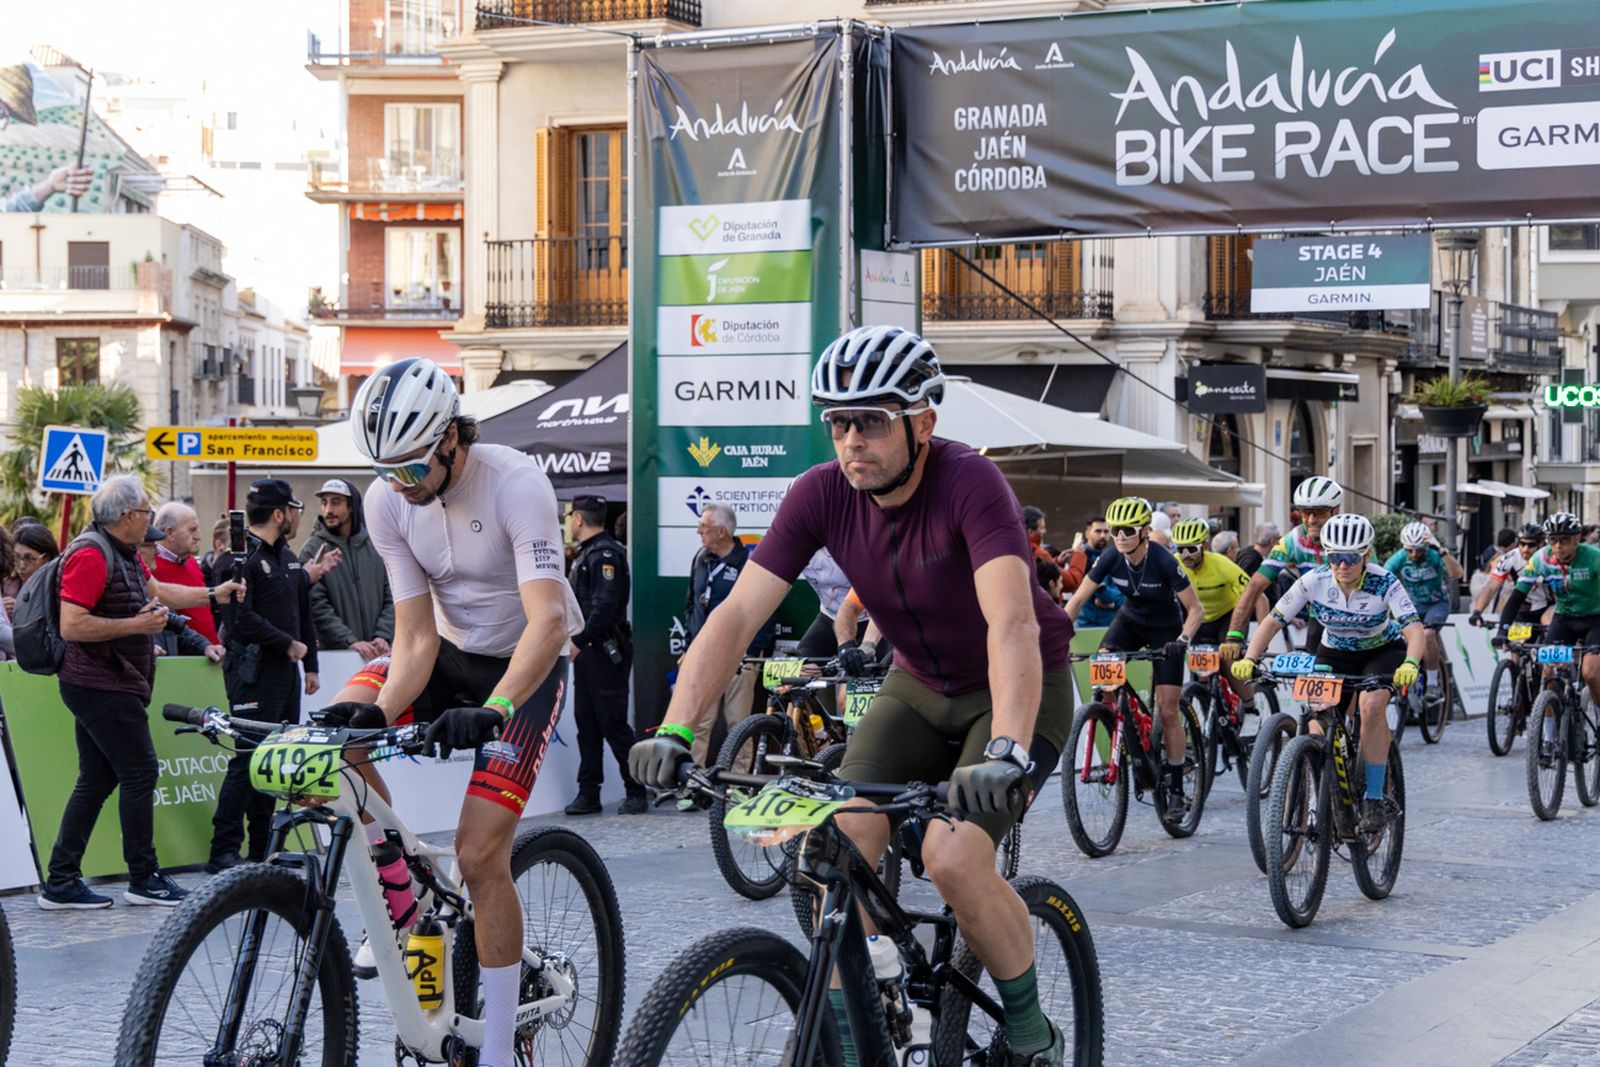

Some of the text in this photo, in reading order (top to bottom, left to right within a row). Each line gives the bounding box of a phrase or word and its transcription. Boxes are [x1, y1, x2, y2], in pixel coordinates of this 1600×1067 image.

[929, 47, 1022, 76] Andalucía
[1493, 56, 1600, 83] UCI SH
[1110, 28, 1458, 125] Andalucía
[668, 99, 803, 141] Andalucía
[954, 103, 1047, 131] GRANADA
[1498, 122, 1600, 148] GARM
[974, 131, 1026, 160] JAÉN
[1115, 112, 1476, 186] BIKE RACE BY
[954, 163, 1047, 192] CÓRDOBA
[722, 220, 778, 232] Diputación
[722, 231, 781, 242] de Granada
[1298, 242, 1382, 262] STAGE 4
[1313, 265, 1366, 282] JAÉN
[1307, 293, 1372, 305] GARMIN
[722, 320, 779, 332] Diputación
[722, 331, 780, 343] de Córdoba
[675, 380, 796, 400] GARMIN
[207, 434, 267, 442] aparcamiento
[272, 434, 314, 442] municipal
[207, 445, 314, 456] San Francisco
[723, 444, 787, 455] CAJA RURAL
[741, 456, 768, 468] JAÉN
[715, 491, 785, 501] SCIENTIFFIC
[1191, 653, 1217, 667] 705-1
[1276, 656, 1312, 669] 518-2
[1541, 648, 1570, 660] 518-1
[1092, 664, 1123, 680] 705-2
[1299, 679, 1338, 699] 708-1
[158, 751, 233, 777] PUTACIÓ
[174, 781, 217, 805] JAÉN
[1046, 895, 1081, 932] MAXXIS
